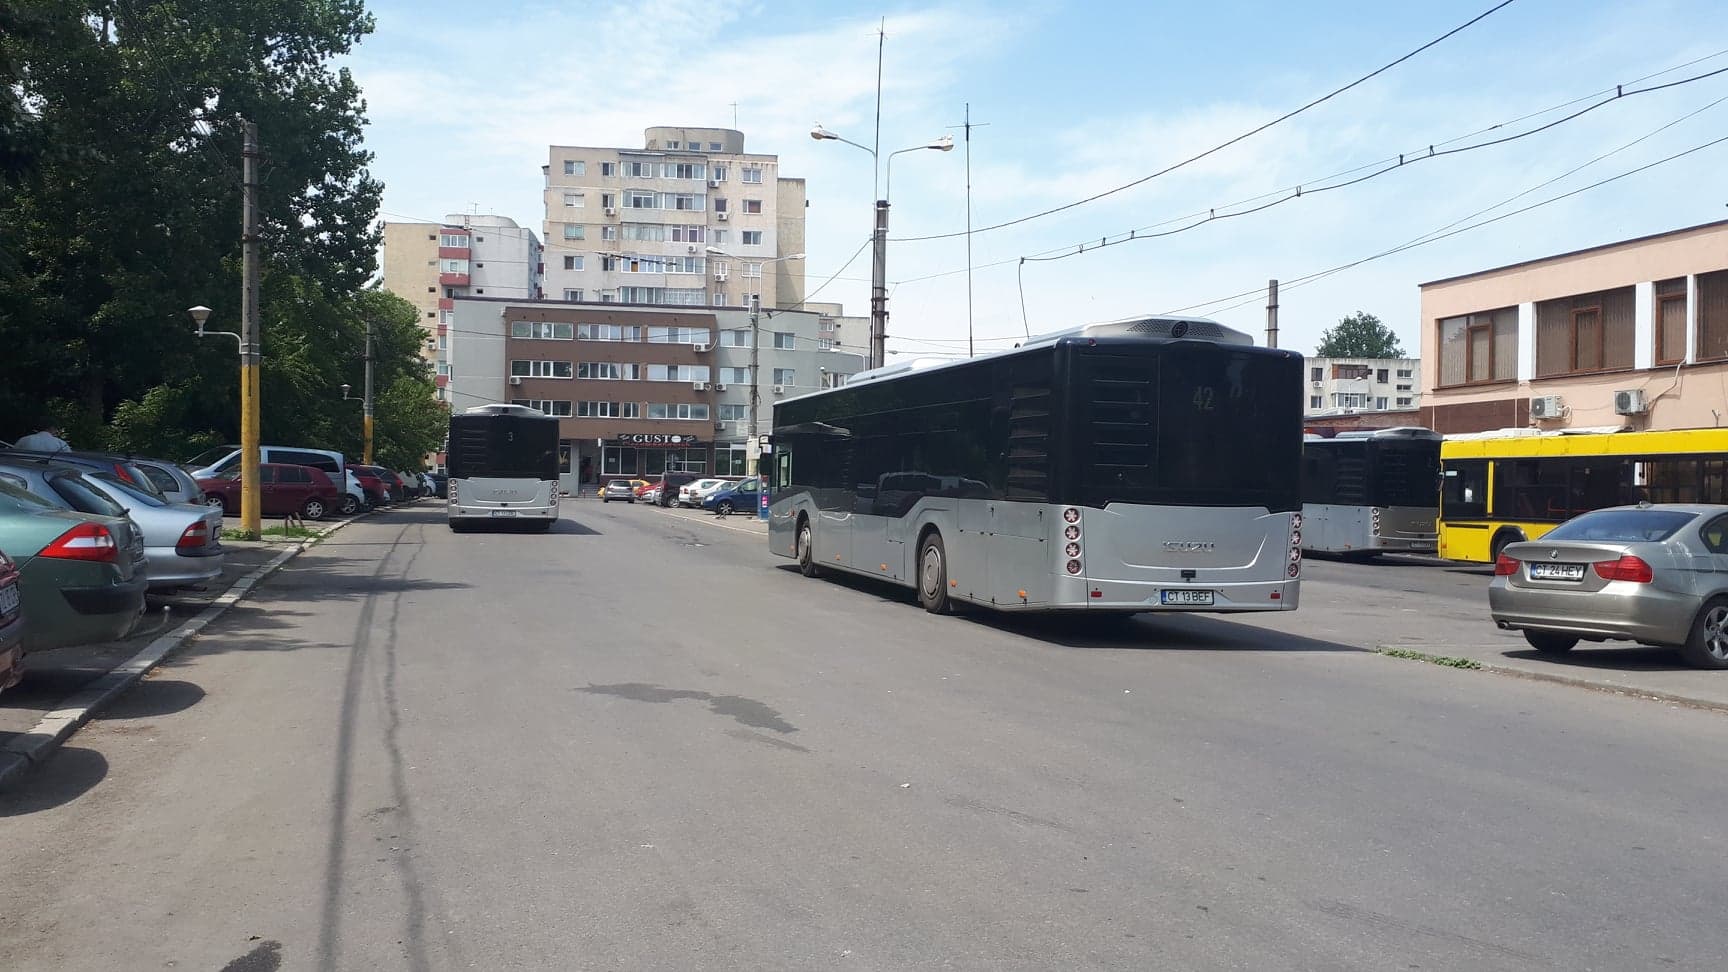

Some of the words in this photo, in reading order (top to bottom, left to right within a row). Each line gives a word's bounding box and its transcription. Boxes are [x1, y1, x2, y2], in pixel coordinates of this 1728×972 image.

[632, 434, 682, 443] GUSTO
[1536, 564, 1546, 575] CT
[1550, 565, 1560, 576] 24
[1561, 565, 1582, 577] HEY
[1168, 591, 1178, 601] CT
[1182, 591, 1191, 601] 13
[1191, 591, 1211, 601] BEF
